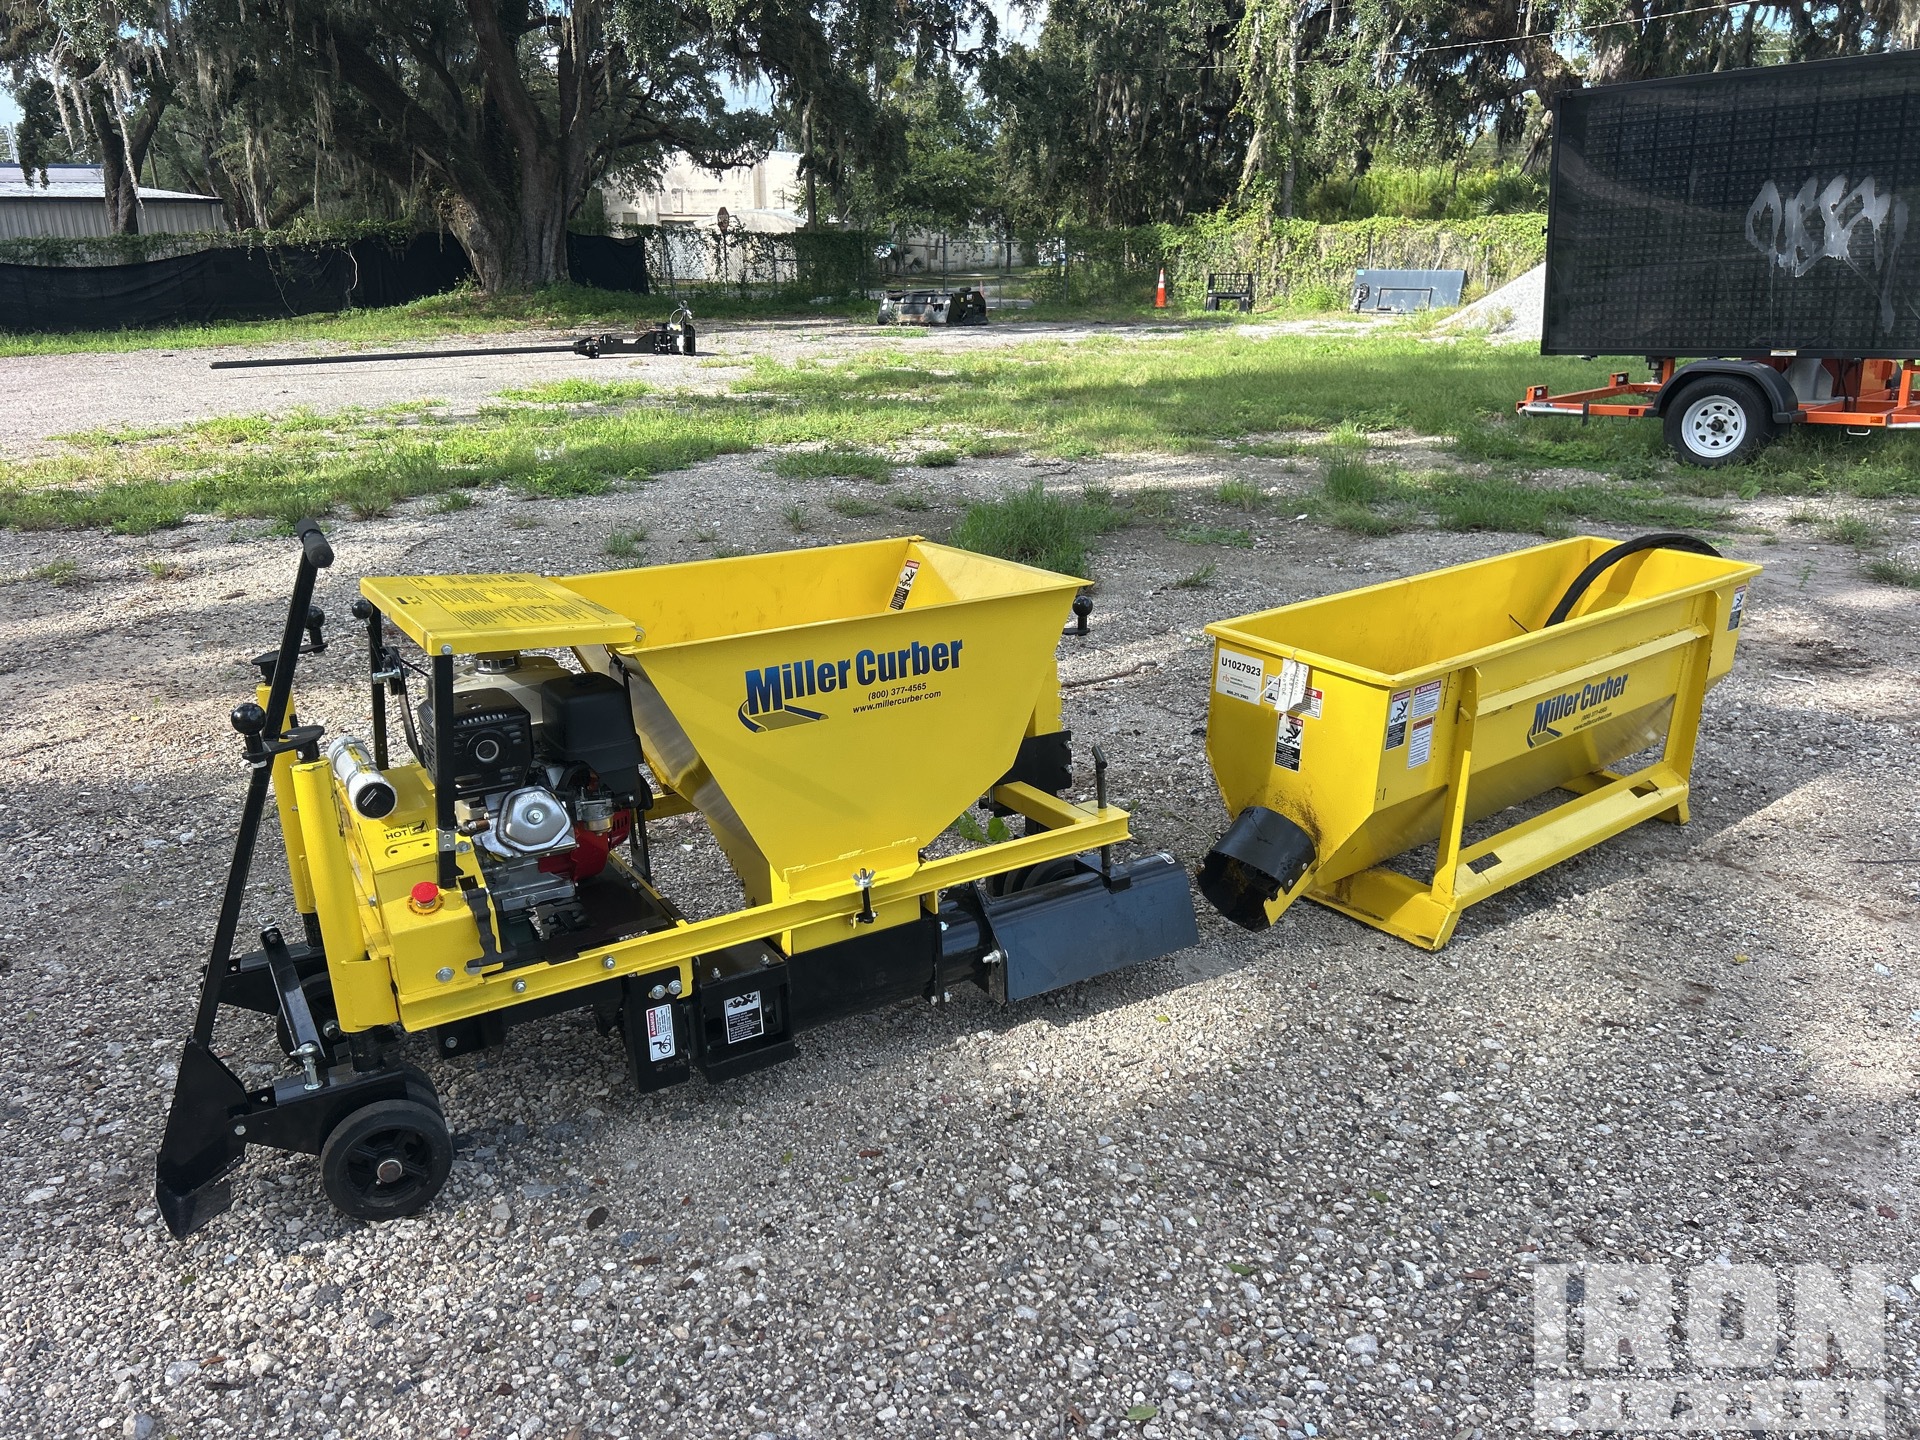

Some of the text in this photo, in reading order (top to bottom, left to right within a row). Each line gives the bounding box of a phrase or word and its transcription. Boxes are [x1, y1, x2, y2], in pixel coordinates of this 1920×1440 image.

[745, 638, 963, 715] Miller Curber
[1221, 656, 1261, 677] U1027923
[868, 682, 927, 702] (800) 377-4565
[1420, 681, 1440, 693] DANGER
[1531, 673, 1629, 736] Miller Curber
[385, 829, 407, 840] HOT
